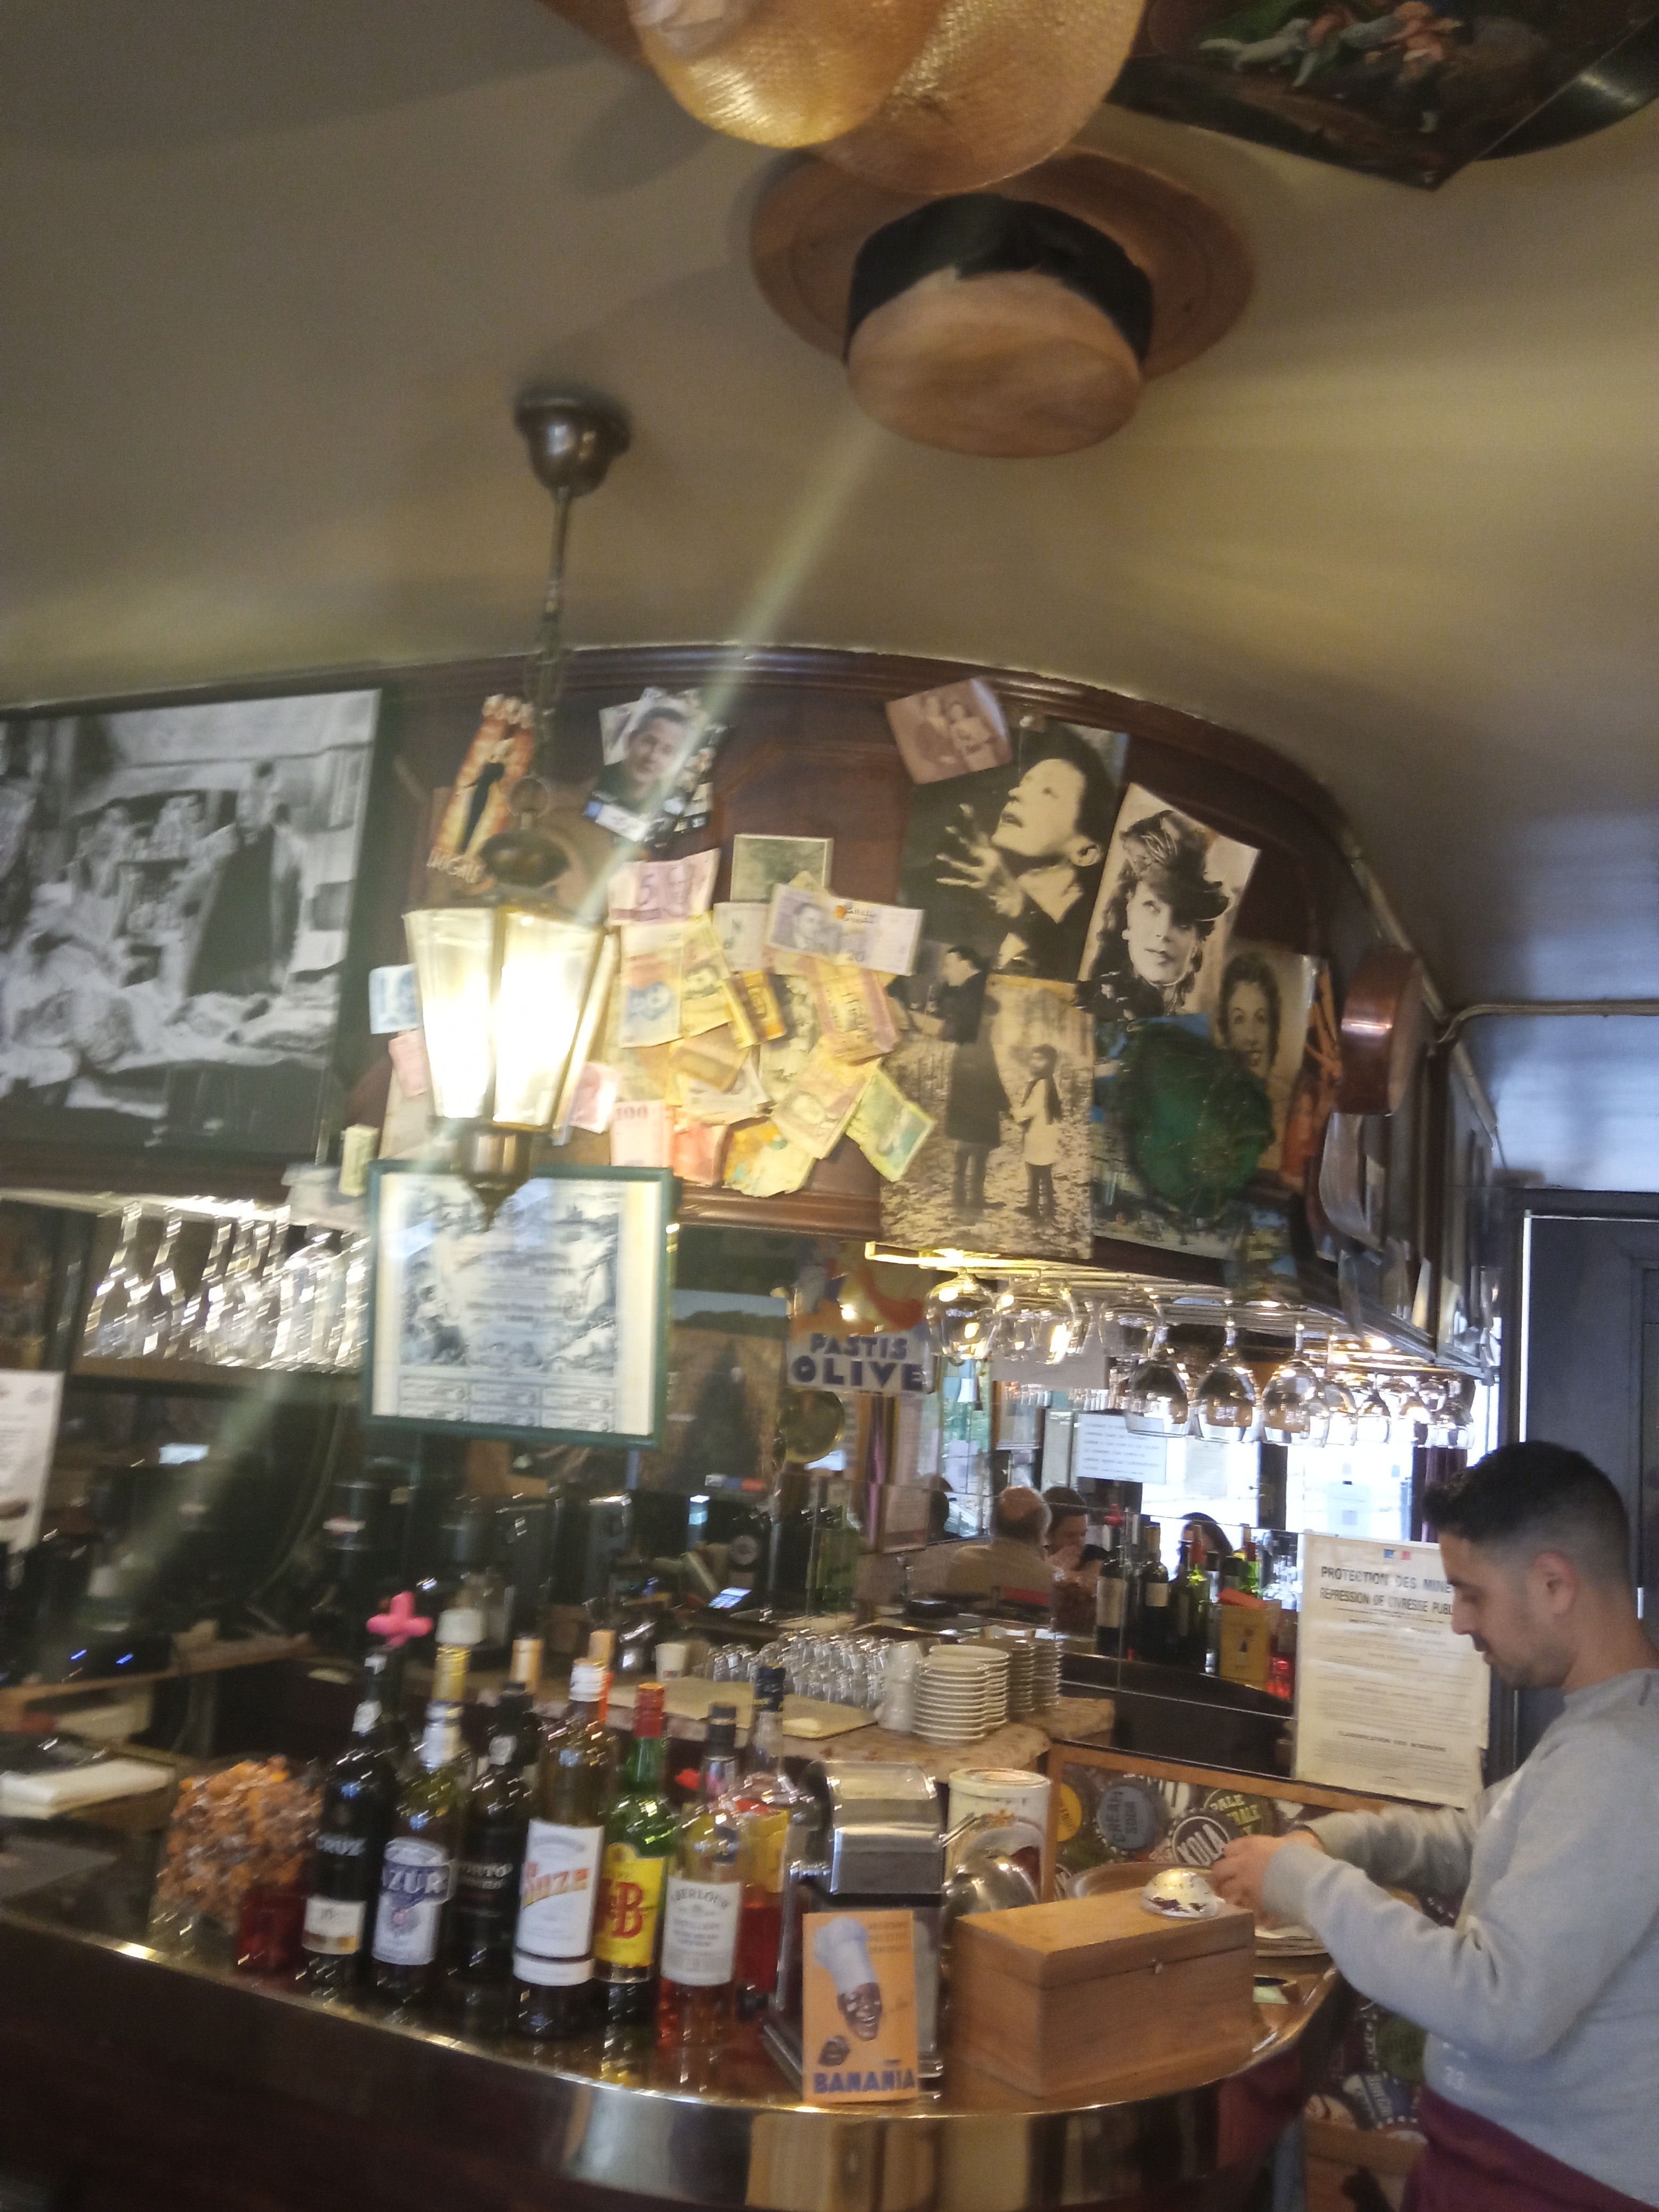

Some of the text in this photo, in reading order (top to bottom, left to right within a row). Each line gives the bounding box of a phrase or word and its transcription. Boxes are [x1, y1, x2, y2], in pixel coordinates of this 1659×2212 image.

[809, 1333, 907, 1360] PASTIS
[792, 1355, 924, 1390] OLIVE
[1321, 1566, 1389, 1585] PROTECTION
[1395, 1576, 1417, 1589] DES
[1373, 1595, 1384, 1606] DE
[814, 2069, 916, 2093] BANANIA
